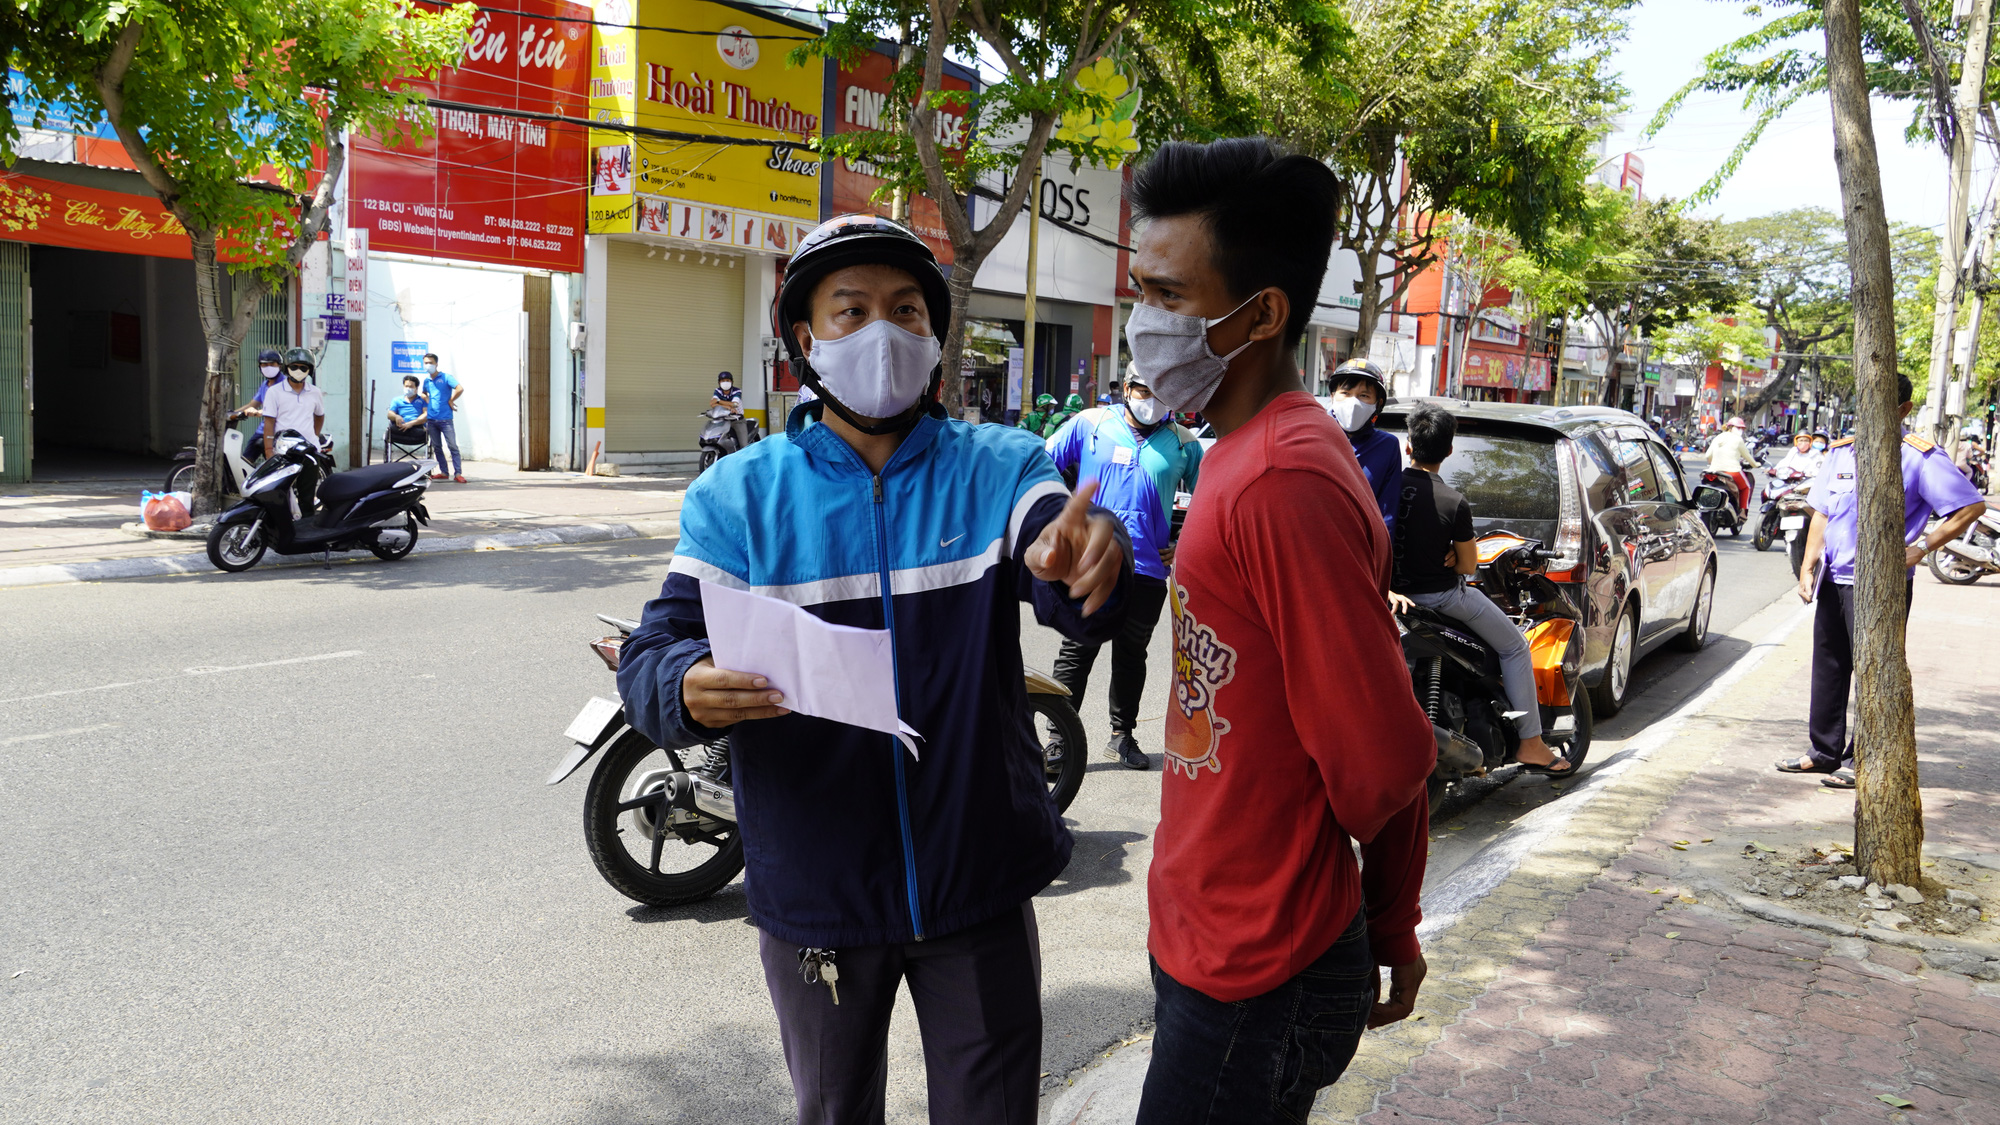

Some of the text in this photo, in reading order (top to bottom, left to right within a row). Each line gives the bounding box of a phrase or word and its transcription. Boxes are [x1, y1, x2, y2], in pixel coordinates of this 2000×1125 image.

[519, 24, 567, 70] tín
[599, 45, 626, 67] Hoài
[645, 62, 715, 115] Hoài
[441, 107, 484, 139] THOẠI,
[487, 115, 514, 142] MÁY
[519, 119, 546, 148] TÍNH
[767, 145, 820, 177] Shoes
[64, 199, 106, 226] Chúc
[103, 206, 156, 240] Mừng
[364, 198, 377, 210] 122
[379, 200, 391, 212] BA
[393, 202, 404, 213] CU
[413, 203, 437, 218] VŨNG
[438, 207, 454, 220] TÀU
[591, 209, 630, 220] 120 BA CU
[379, 218, 402, 233] (BĐS)
[403, 221, 437, 237] Website:
[438, 227, 501, 244] truyentinland.com
[507, 236, 519, 246] ĐT:
[520, 238, 561, 251] 064.625.2222
[484, 215, 497, 226] ĐT:
[498, 217, 541, 232] 064.628.2222
[546, 224, 574, 237] 627.2222
[349, 276, 362, 295] ĐIỆN
